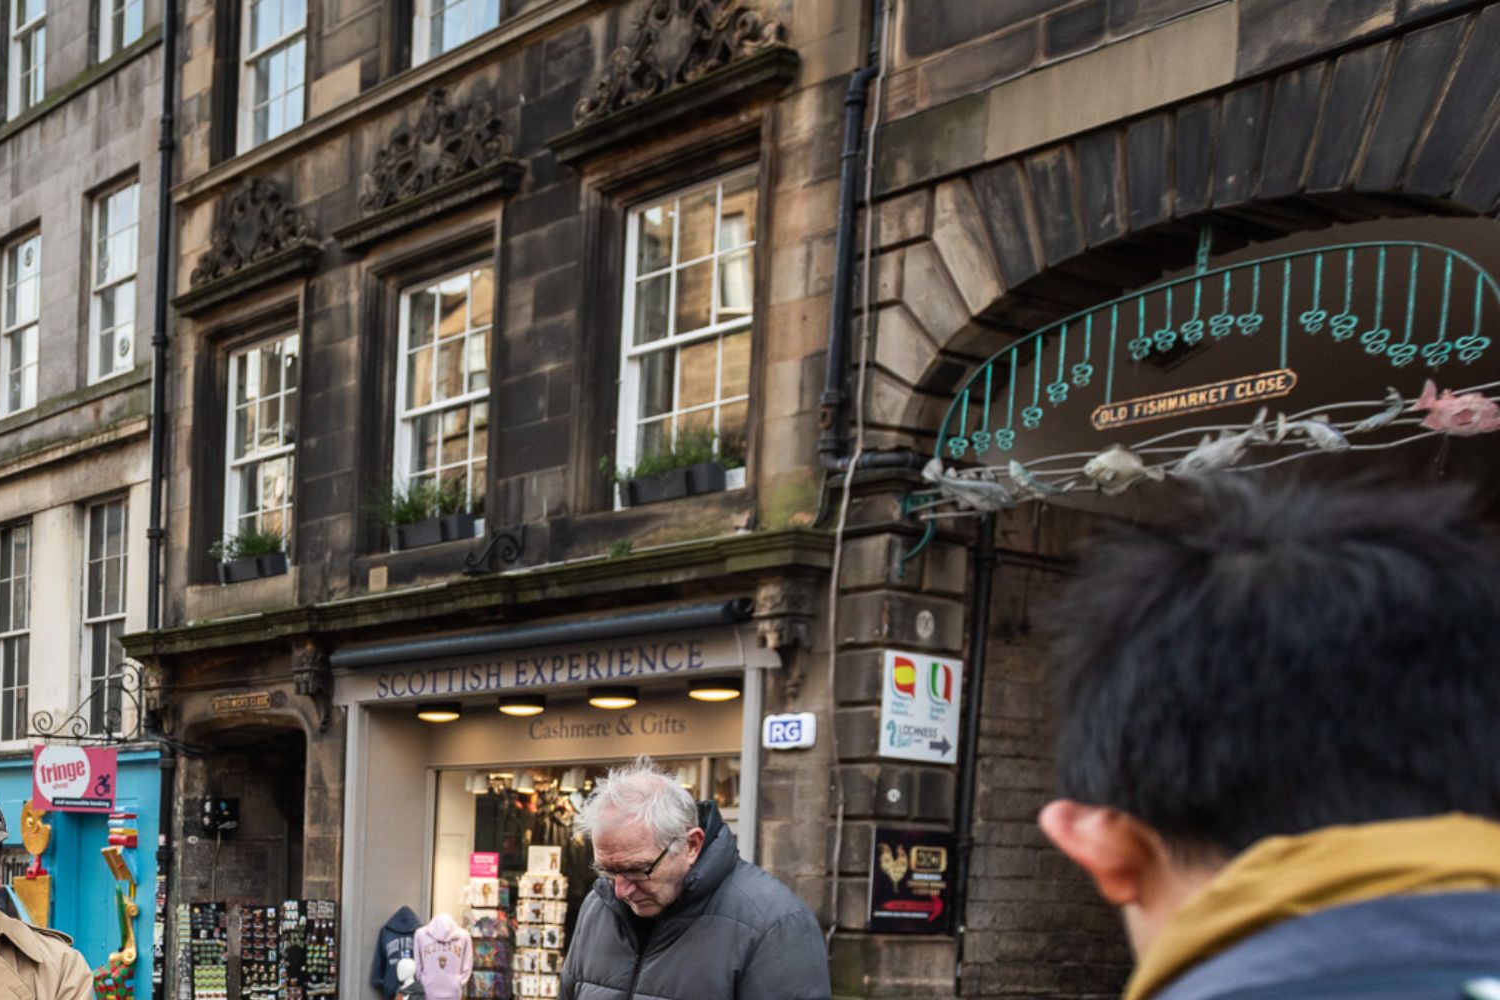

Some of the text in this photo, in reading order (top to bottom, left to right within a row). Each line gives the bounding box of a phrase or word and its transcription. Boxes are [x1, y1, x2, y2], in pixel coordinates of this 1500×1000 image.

[1100, 375, 1286, 424] OLD FISHMARKET CLOSE
[376, 640, 705, 699] SCOTTISH EXPERIENCE
[529, 711, 687, 740] Cashmere & Gifts
[770, 720, 801, 743] RG
[40, 760, 86, 784] fringe
